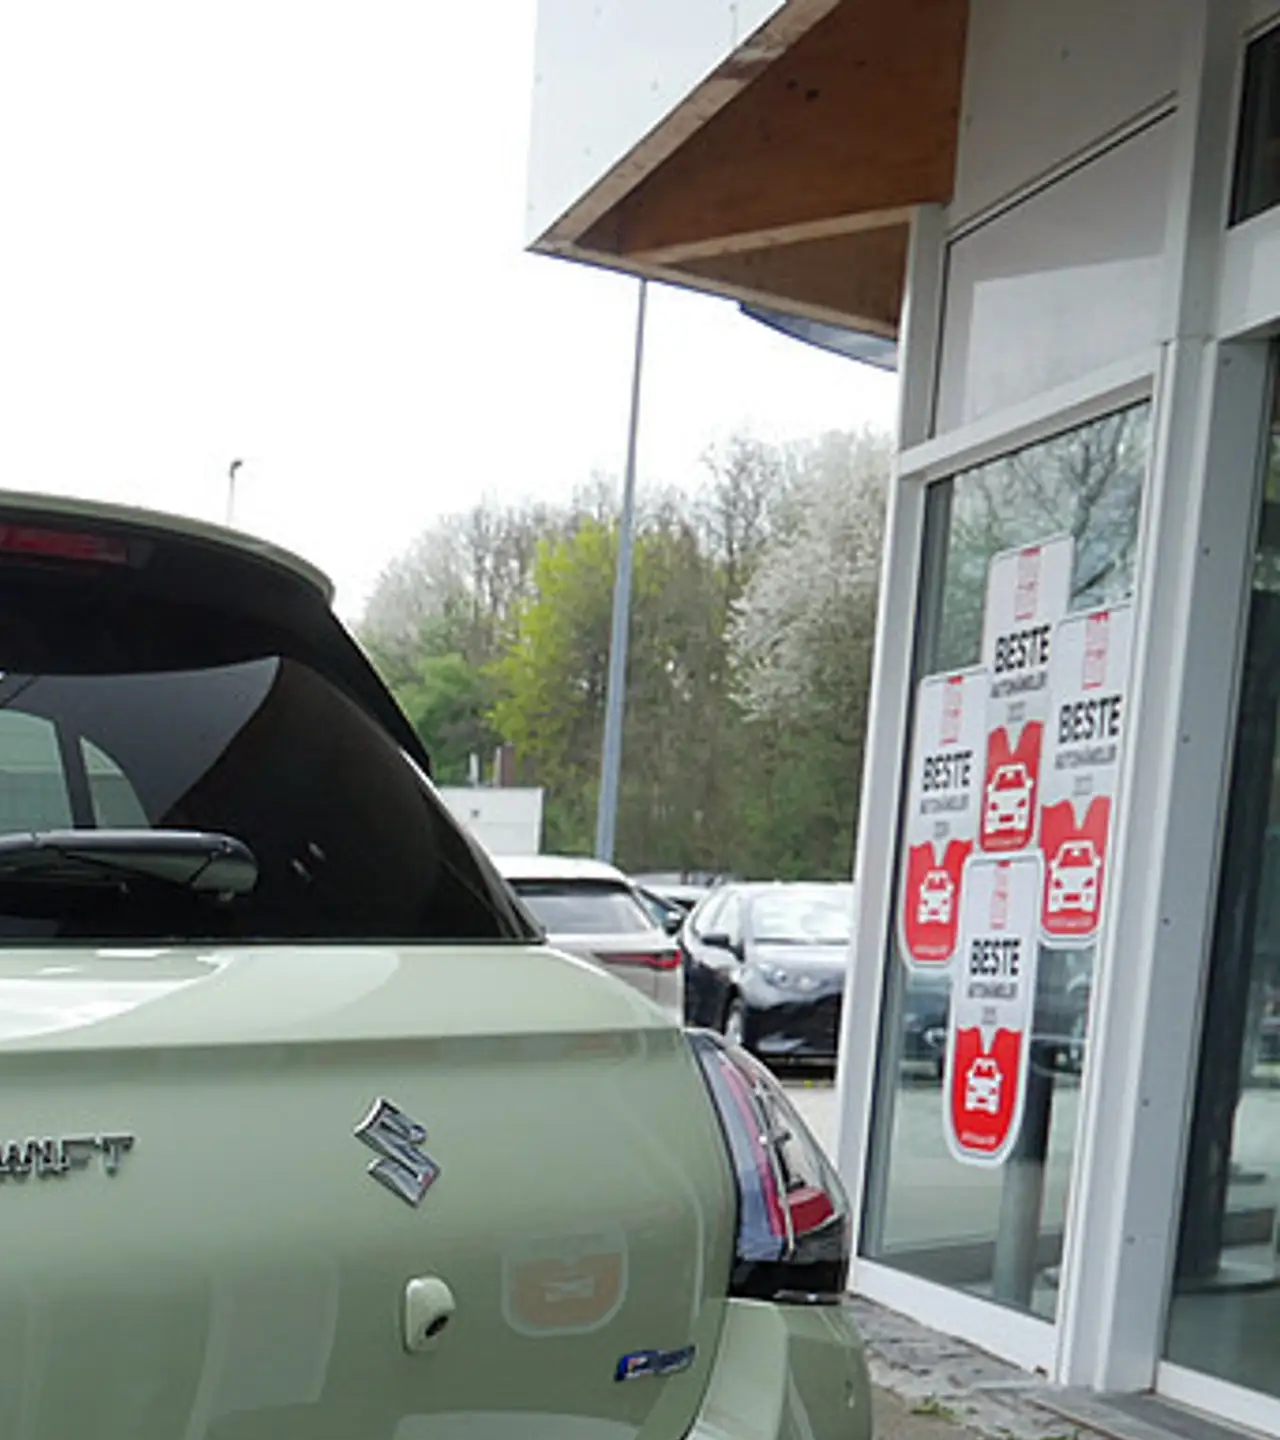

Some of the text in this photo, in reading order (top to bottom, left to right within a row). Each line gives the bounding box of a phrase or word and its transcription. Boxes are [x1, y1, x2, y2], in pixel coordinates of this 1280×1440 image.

[995, 623, 1051, 674] BESTE
[1059, 693, 1122, 744] BESTE
[923, 750, 973, 792] BESTE
[970, 938, 1021, 976] BESTE
